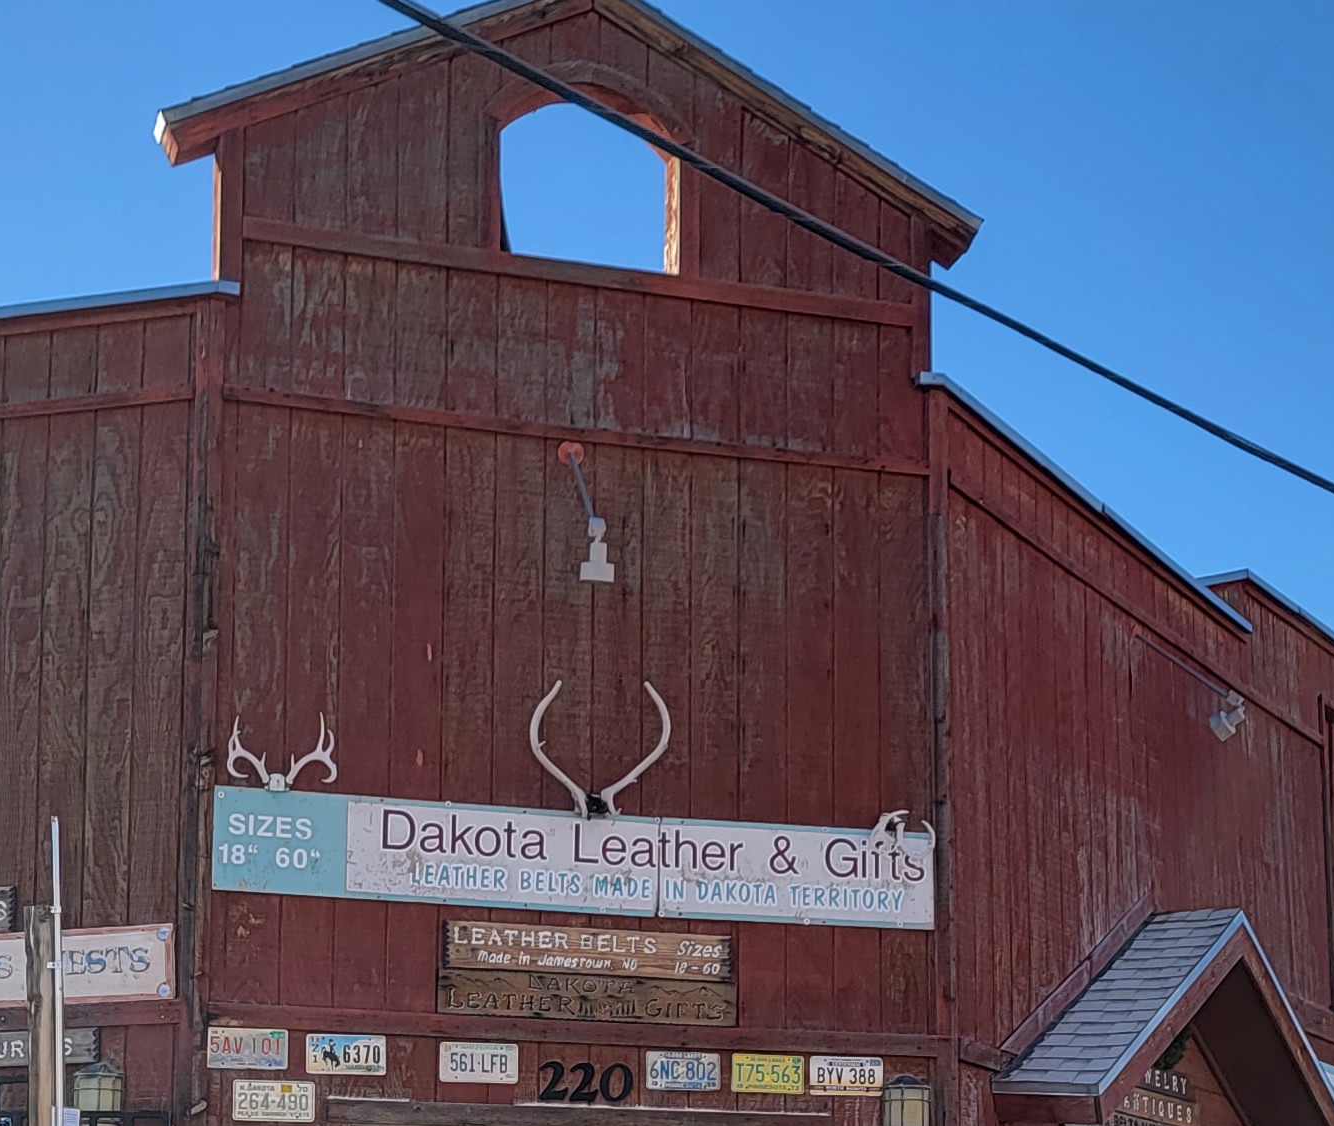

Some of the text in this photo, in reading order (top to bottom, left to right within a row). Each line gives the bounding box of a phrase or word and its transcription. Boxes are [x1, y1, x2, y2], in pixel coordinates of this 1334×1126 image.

[228, 814, 313, 840] SIZES
[381, 808, 925, 882] Dakota Leather & Gifts
[411, 864, 904, 912] LEATHER BELTS MADE IN DAKOTA TERRITORY
[453, 926, 723, 958] LEATHER BELTS Sizes
[62, 946, 151, 976] ESTS
[518, 951, 530, 966] in
[528, 974, 635, 995] DAKOTA
[446, 986, 575, 1016] LEATHER
[644, 998, 726, 1022] GIFTS
[343, 1045, 381, 1064] 6370
[539, 1060, 634, 1101] 220
[686, 1062, 717, 1081] 802
[818, 1068, 876, 1085] BYV 388
[1144, 1068, 1188, 1096] WELRY
[238, 1093, 309, 1111] 264-490
[1123, 1094, 1193, 1124] ANTIQUES
